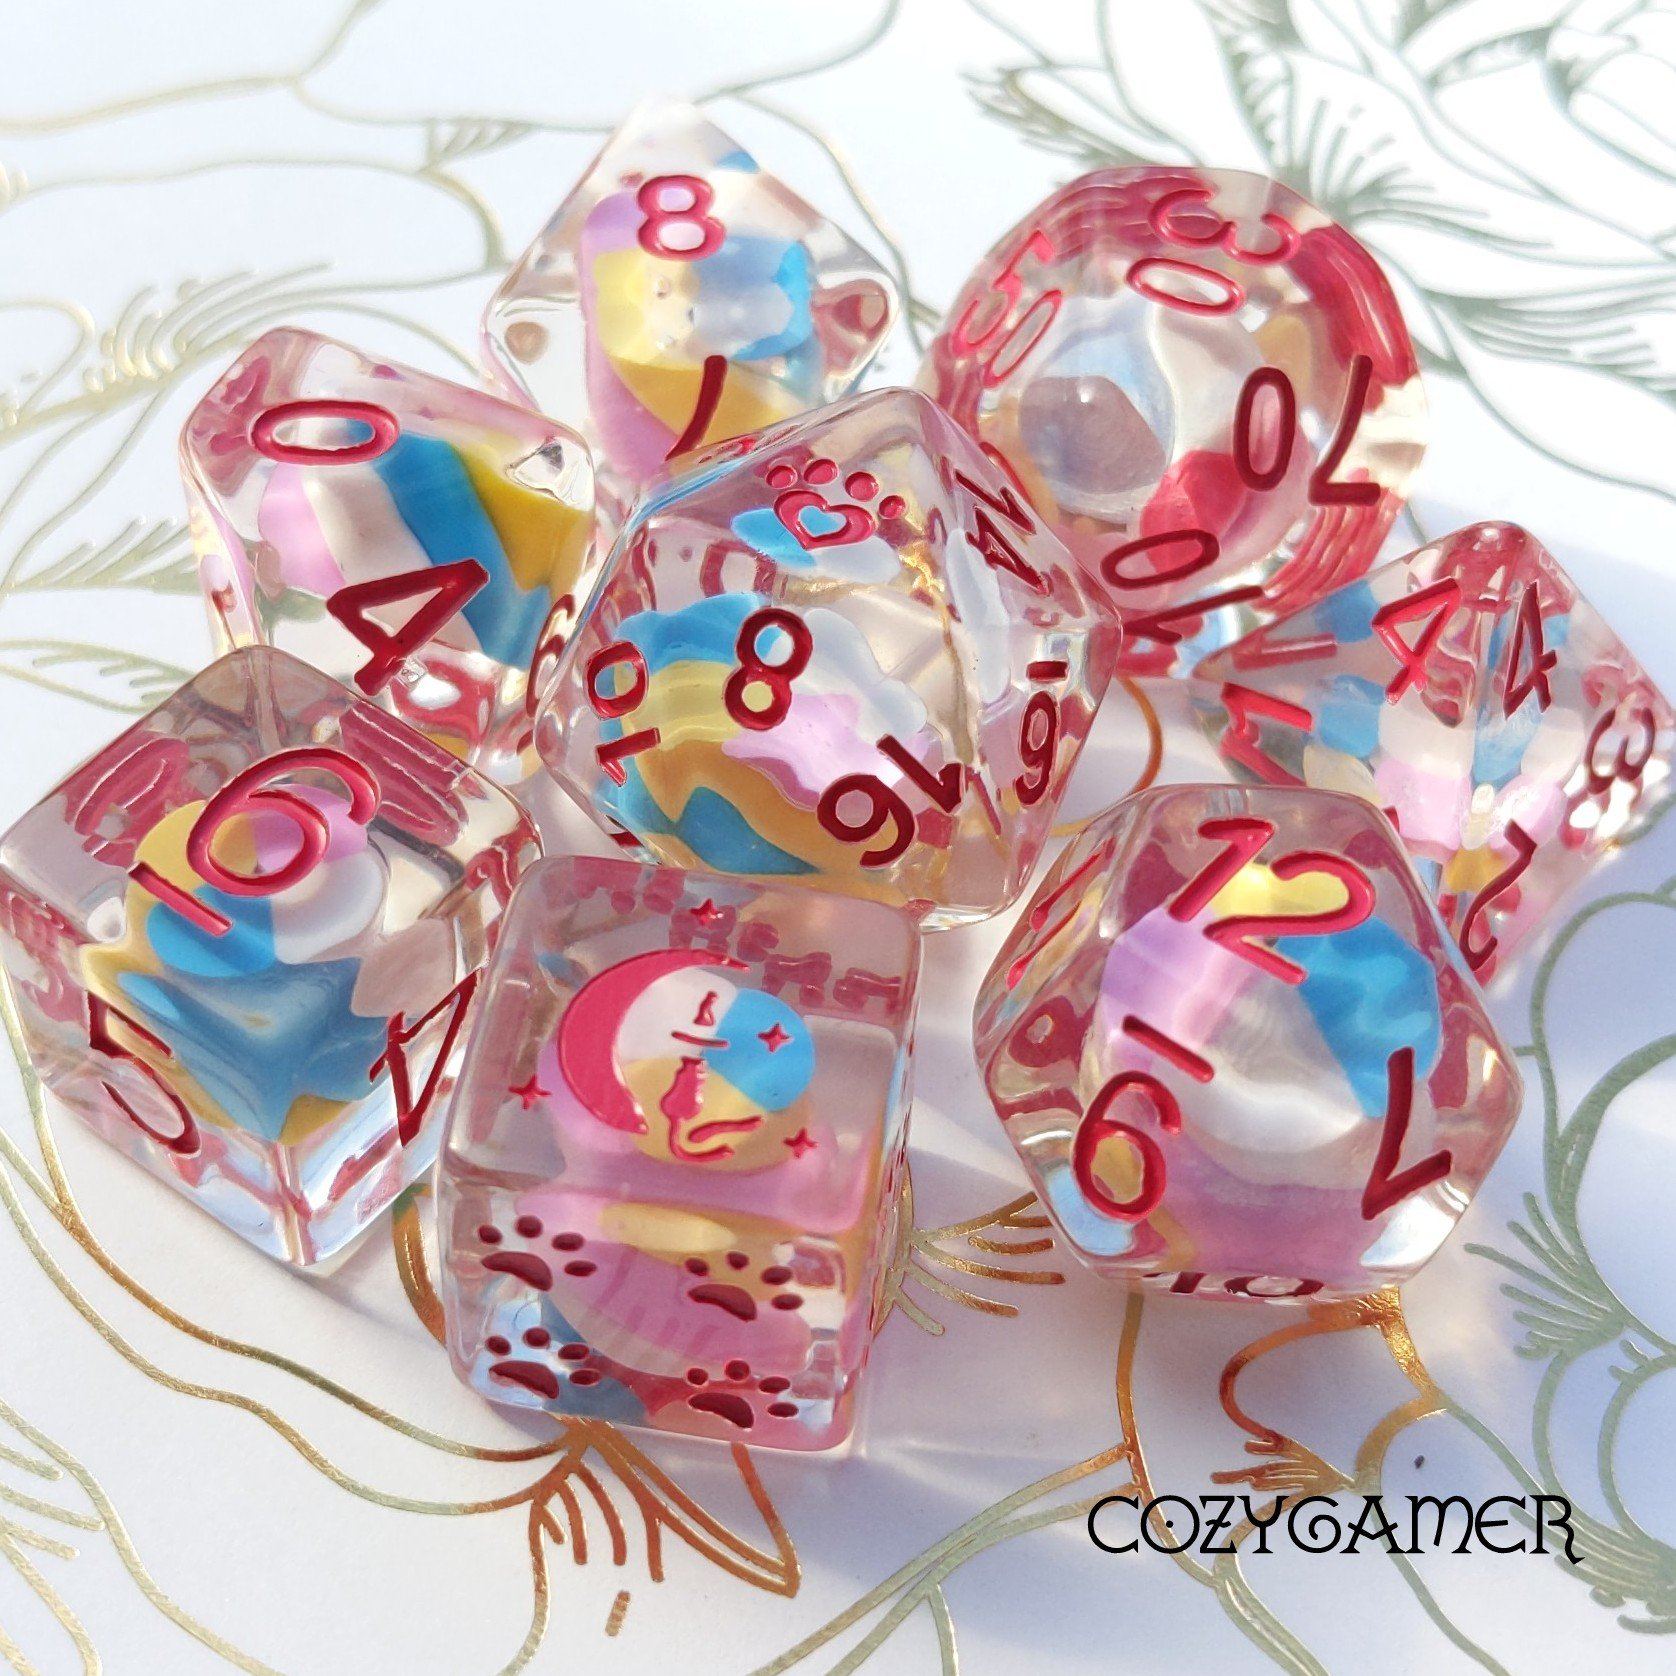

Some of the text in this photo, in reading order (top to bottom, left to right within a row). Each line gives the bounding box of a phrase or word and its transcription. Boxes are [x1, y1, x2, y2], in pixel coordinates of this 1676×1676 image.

[637, 175, 726, 261] 8
[326, 558, 490, 696] 4
[721, 608, 813, 731] 8
[1371, 576, 1466, 704] 4
[1503, 580, 1557, 721] 4
[1168, 817, 1377, 985] 12
[369, 969, 478, 1148] 4
[1361, 1047, 1453, 1221] 7
